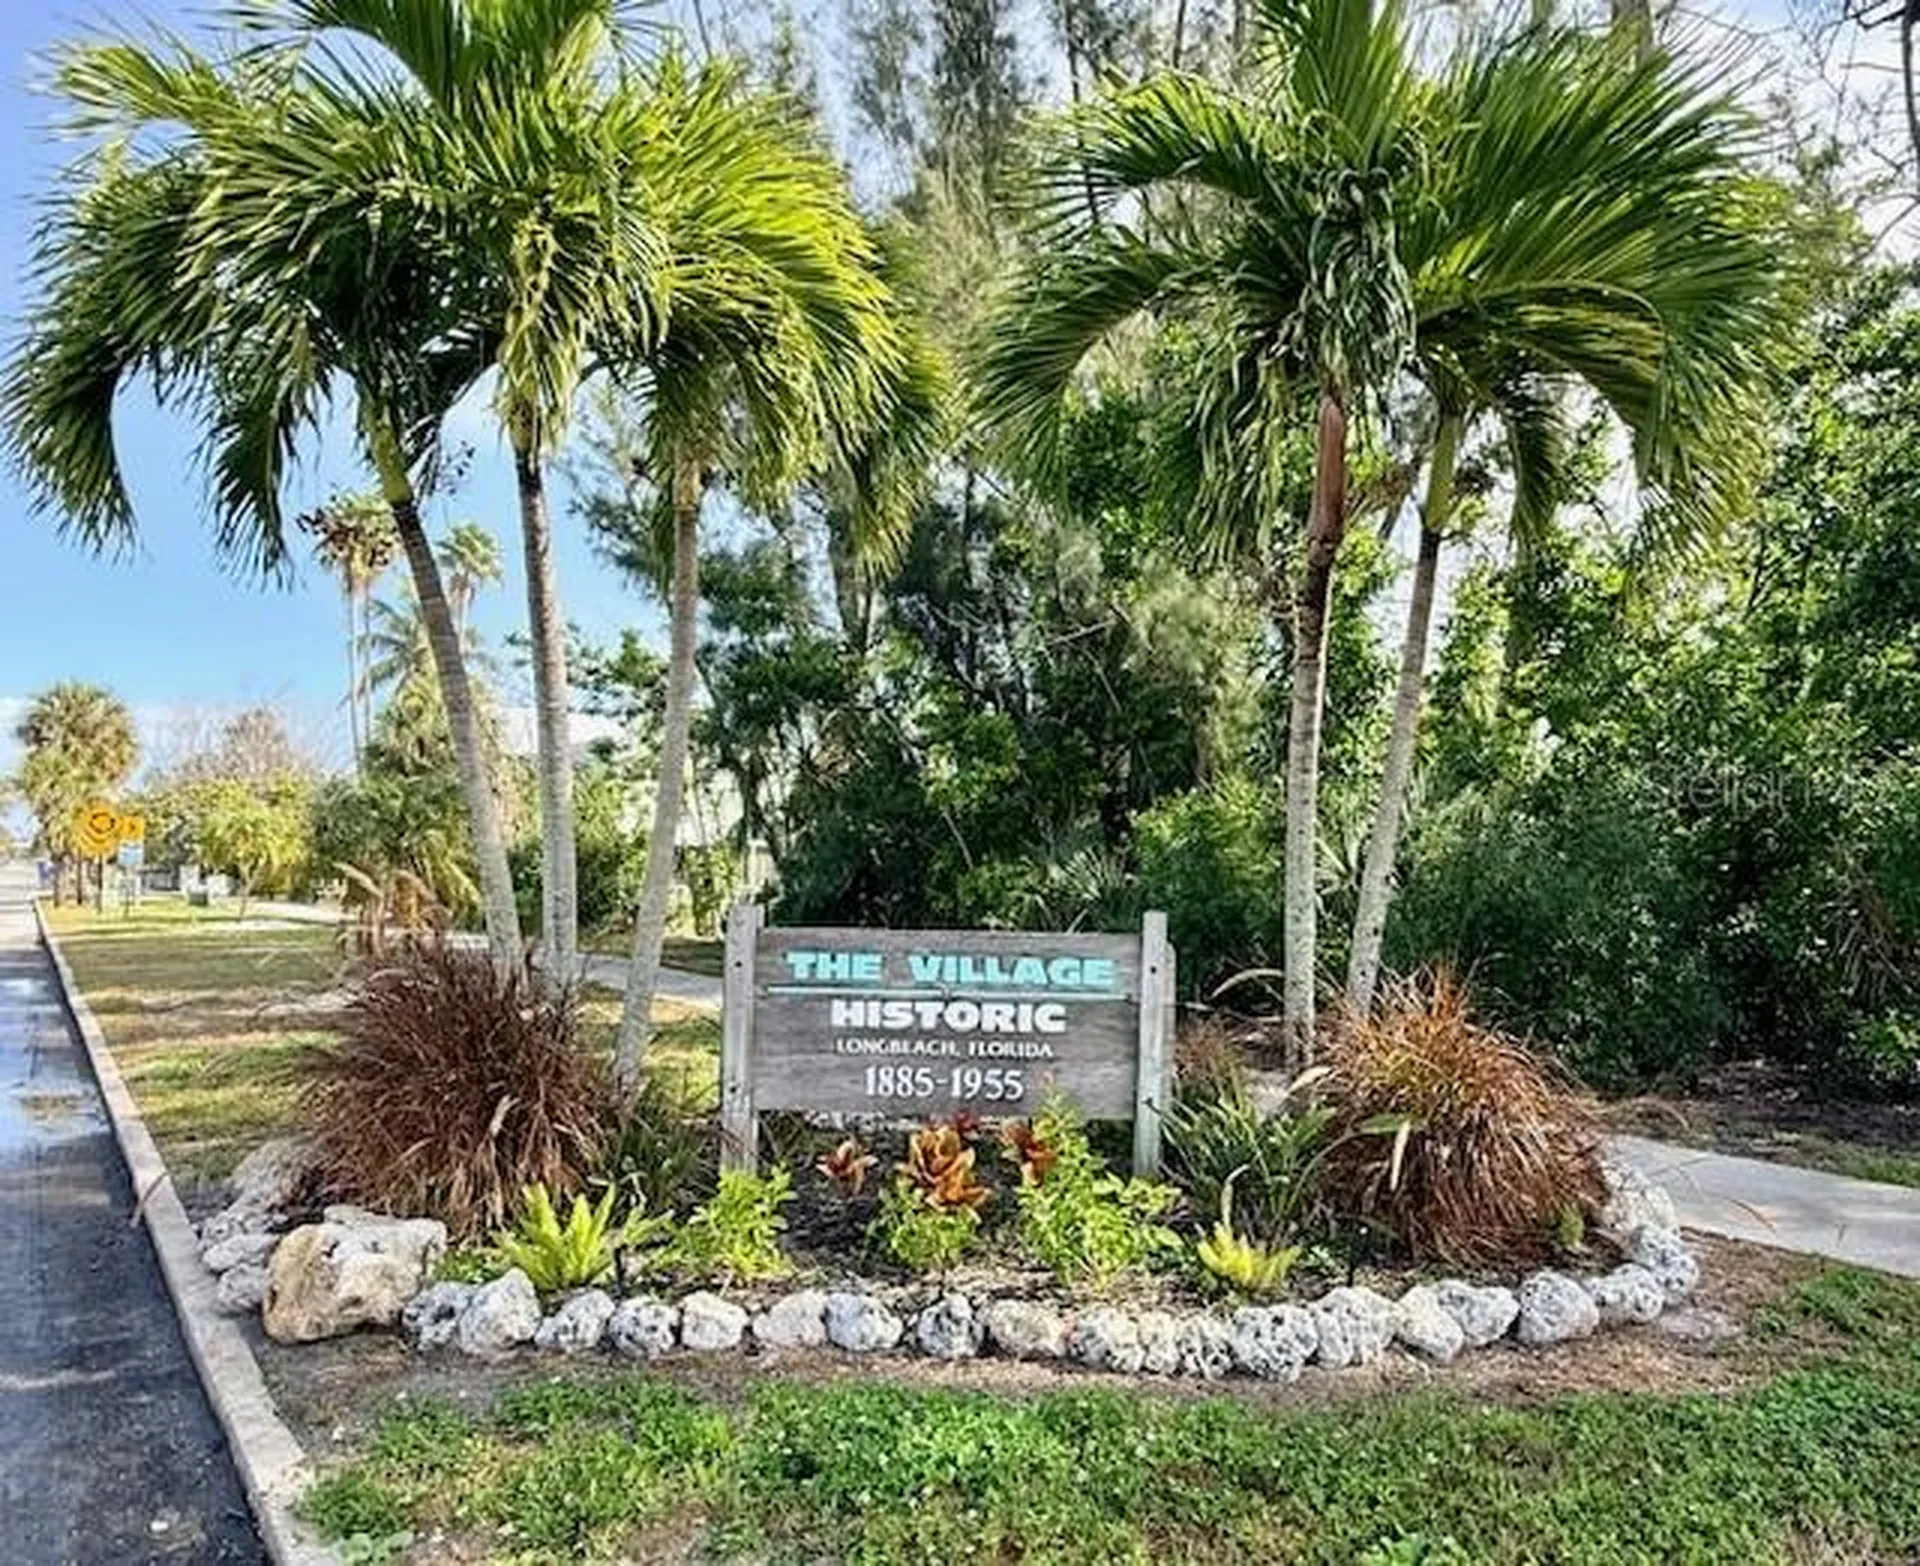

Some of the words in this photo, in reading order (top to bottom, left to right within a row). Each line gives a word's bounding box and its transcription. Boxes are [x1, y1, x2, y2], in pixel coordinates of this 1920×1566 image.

[785, 951, 883, 981] THE
[909, 954, 1115, 987] VILLAGE
[830, 1000, 1067, 1033] HISTORIC
[968, 1040, 1054, 1059] FLORIDA
[864, 1065, 1024, 1100] 1885-1955
